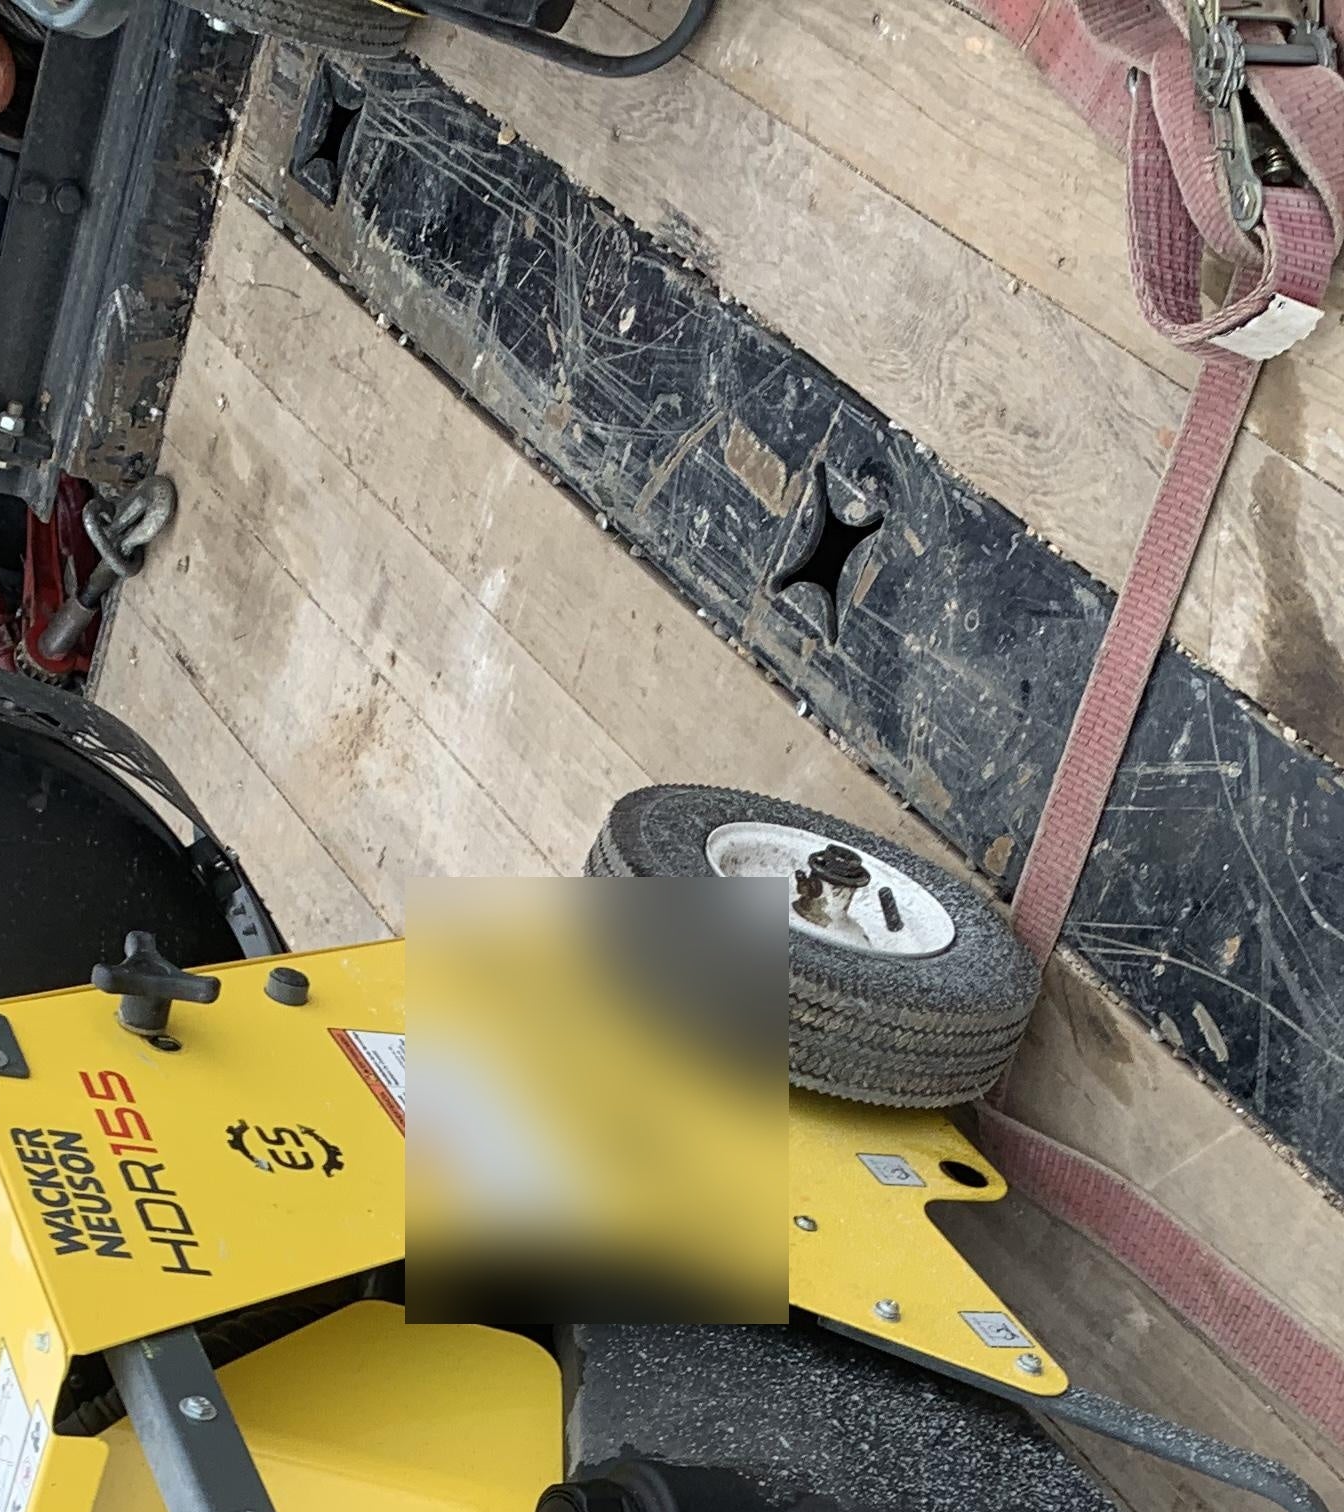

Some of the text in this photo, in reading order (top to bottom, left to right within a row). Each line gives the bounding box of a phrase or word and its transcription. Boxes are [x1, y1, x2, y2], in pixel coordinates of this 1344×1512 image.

[10, 1127, 90, 1256] WACKER
[47, 1129, 133, 1259] NEUSON
[78, 1070, 213, 1276] HDR155
